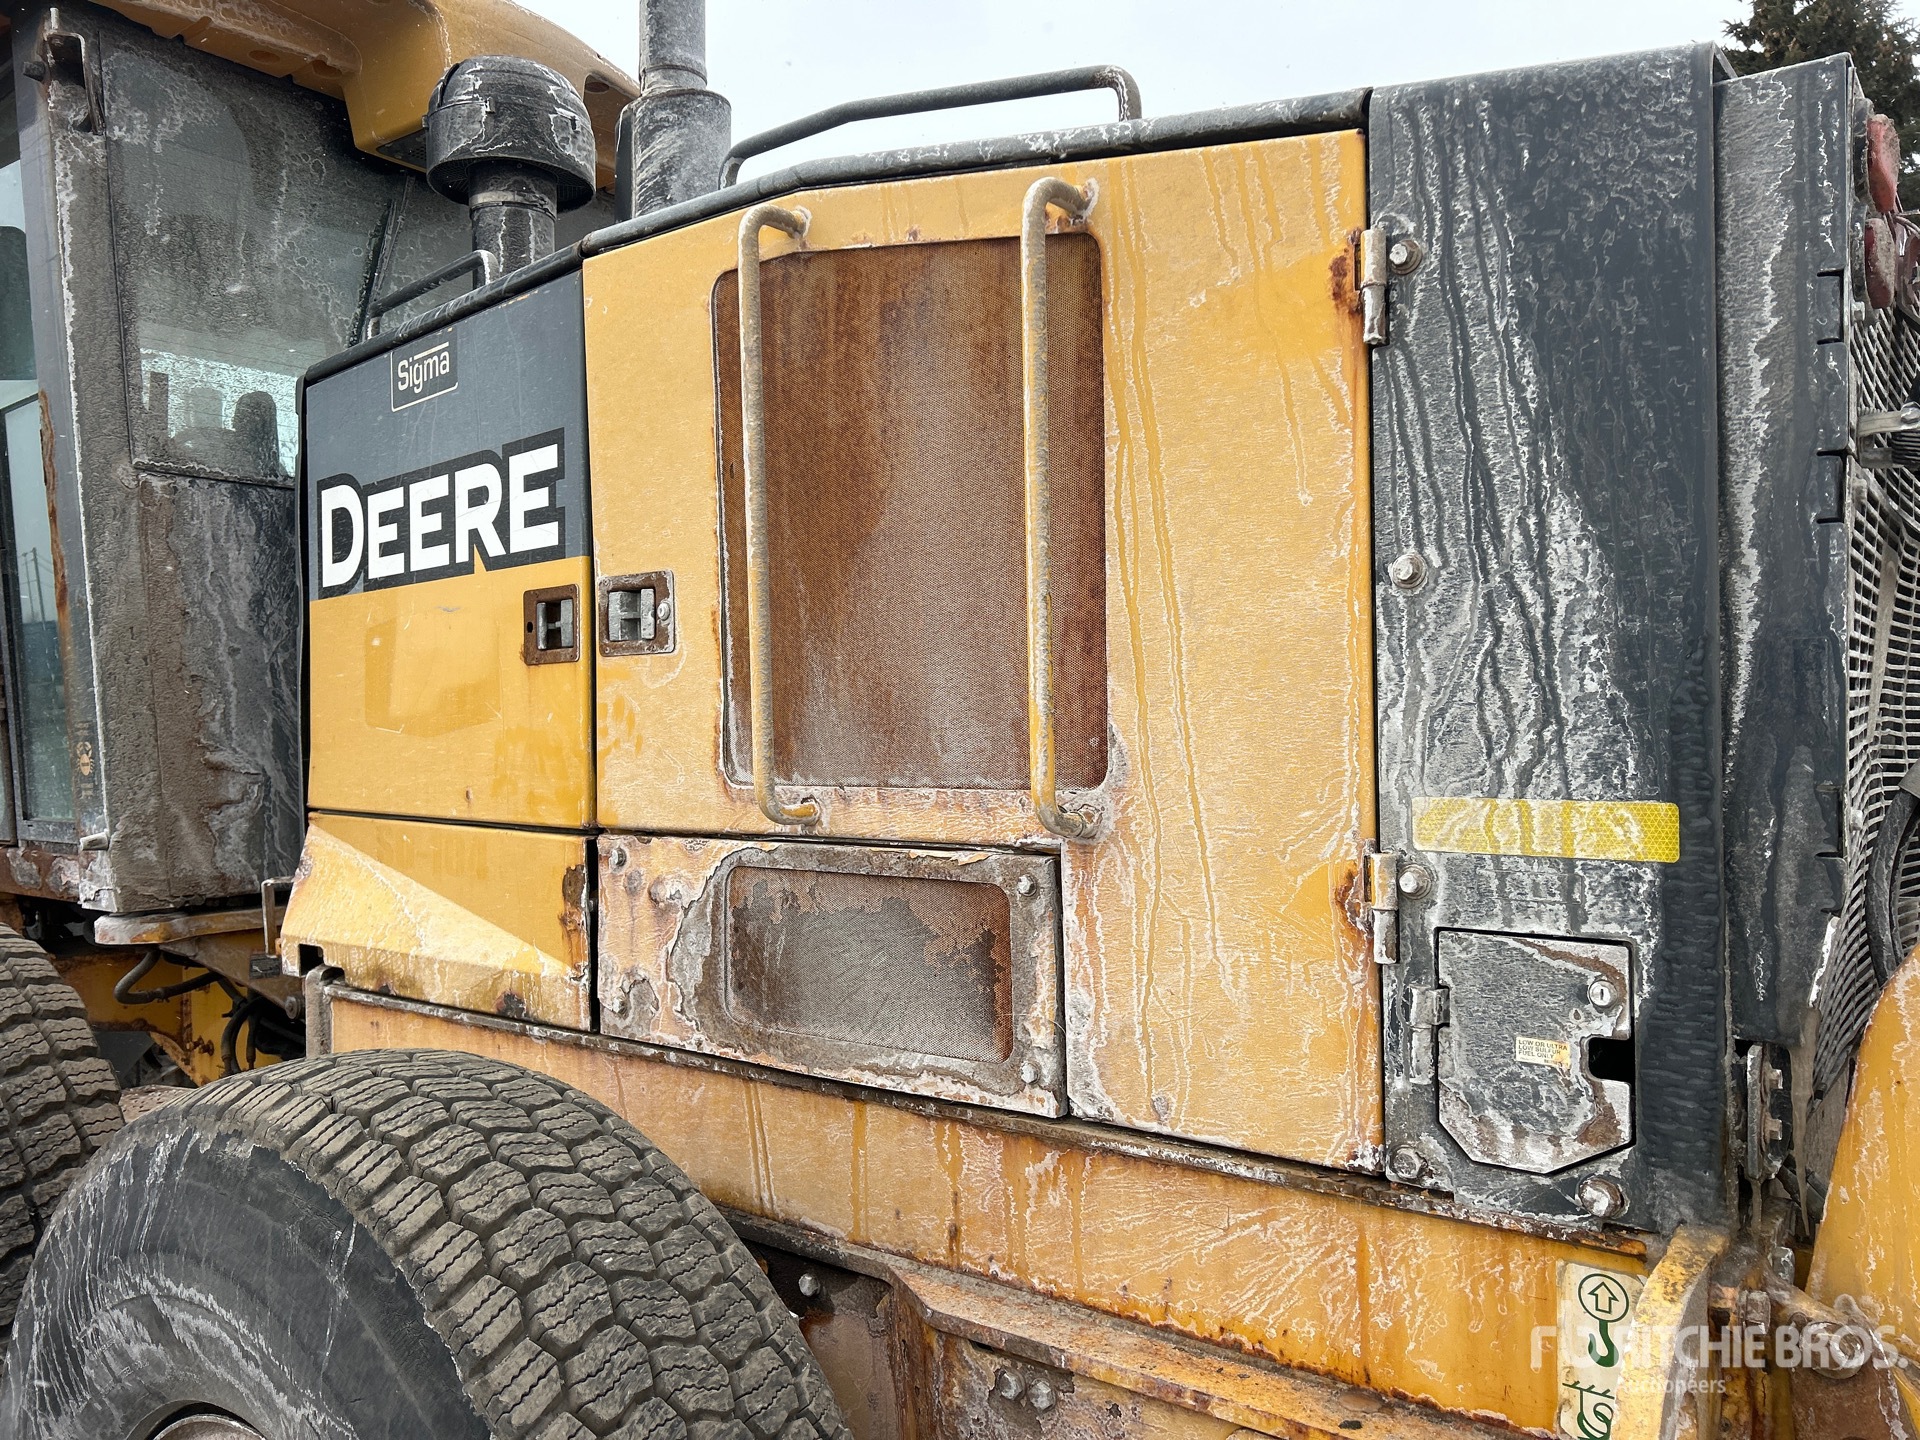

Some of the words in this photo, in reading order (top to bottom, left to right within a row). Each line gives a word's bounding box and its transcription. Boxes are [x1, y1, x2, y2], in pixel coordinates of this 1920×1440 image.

[398, 350, 450, 393] Sigma
[321, 443, 559, 588] DEERE
[1535, 1047, 1561, 1055] SULFUR
[1546, 1043, 1568, 1051] ULTRA
